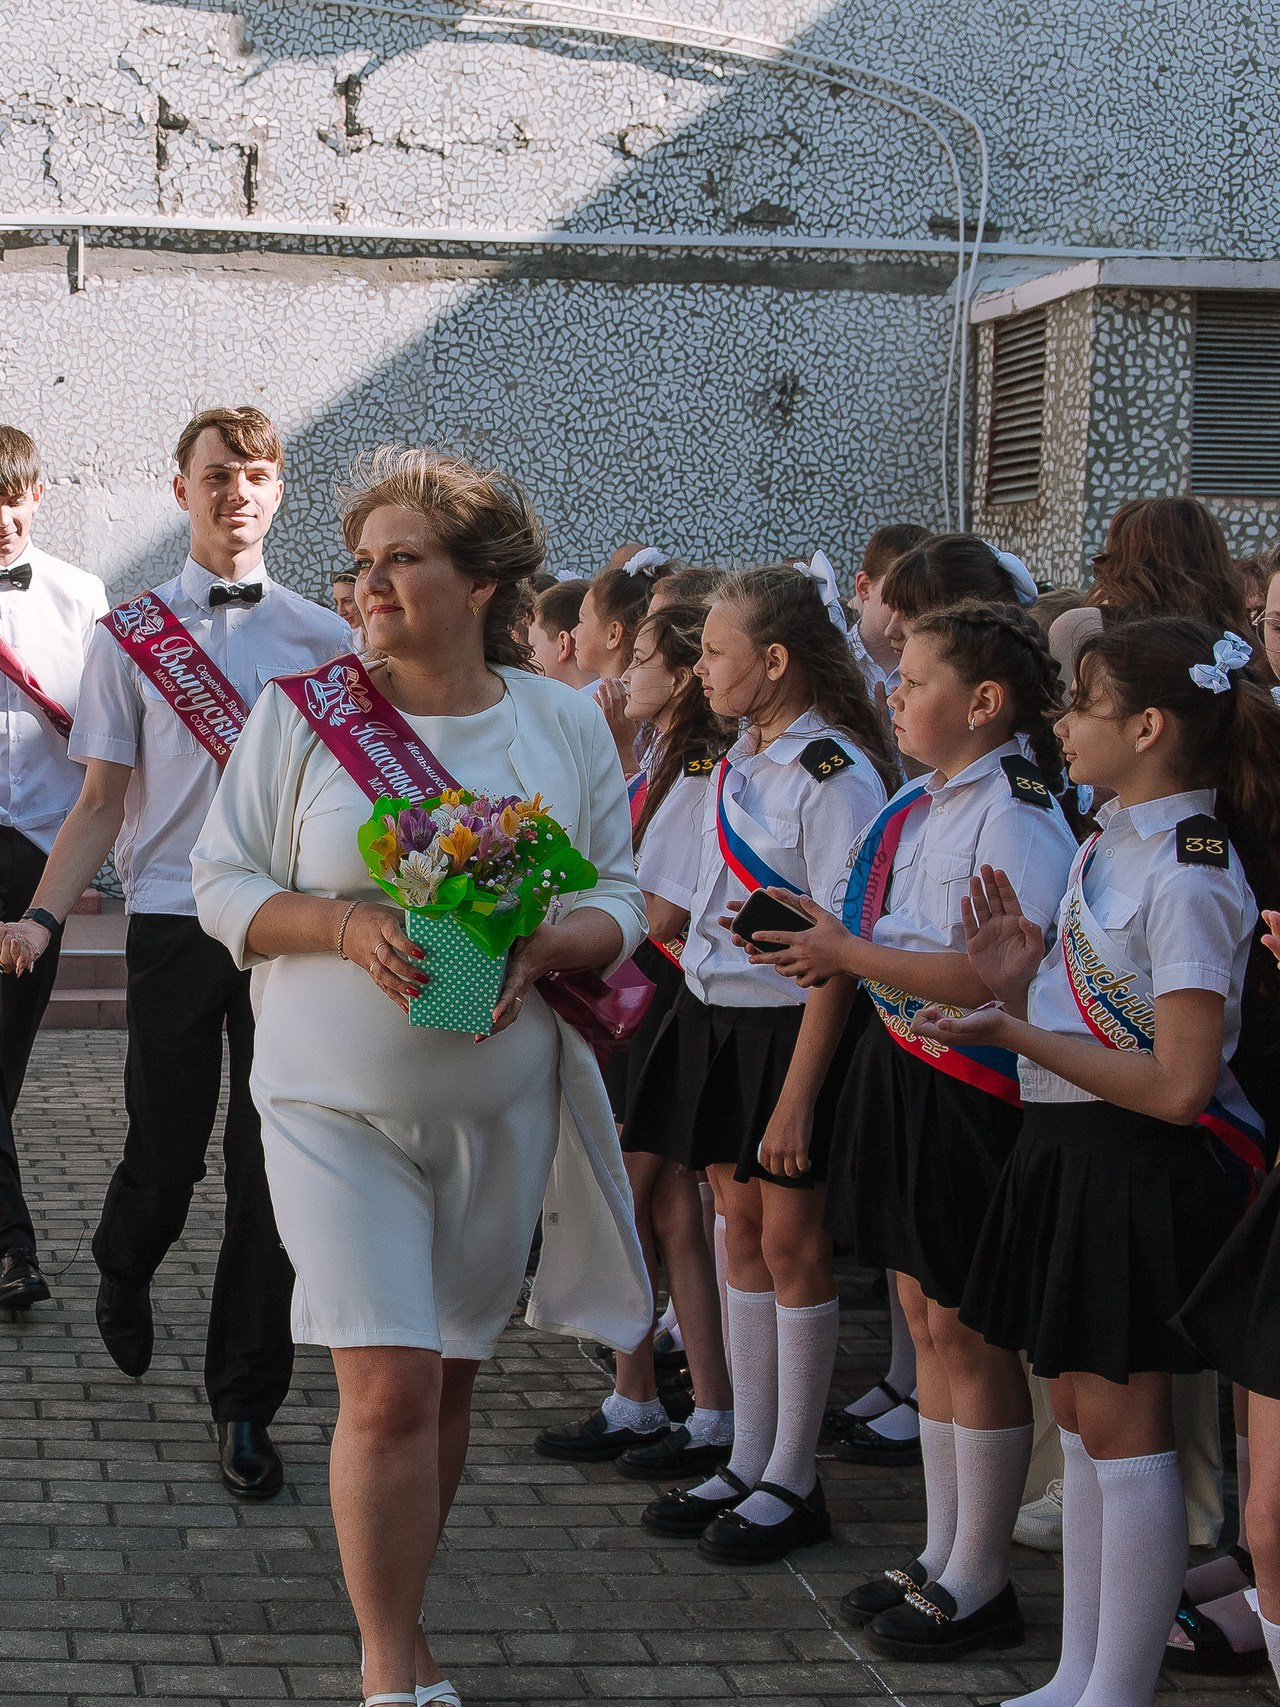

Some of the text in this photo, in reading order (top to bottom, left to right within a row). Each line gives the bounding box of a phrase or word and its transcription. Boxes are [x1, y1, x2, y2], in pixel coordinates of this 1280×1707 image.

[196, 664, 230, 702] Середюк
[153, 669, 228, 756] МАОУ СОШ №33
[688, 758, 714, 772] 33
[818, 754, 845, 774] 33
[1016, 776, 1047, 795] 33
[1185, 837, 1223, 854] 33
